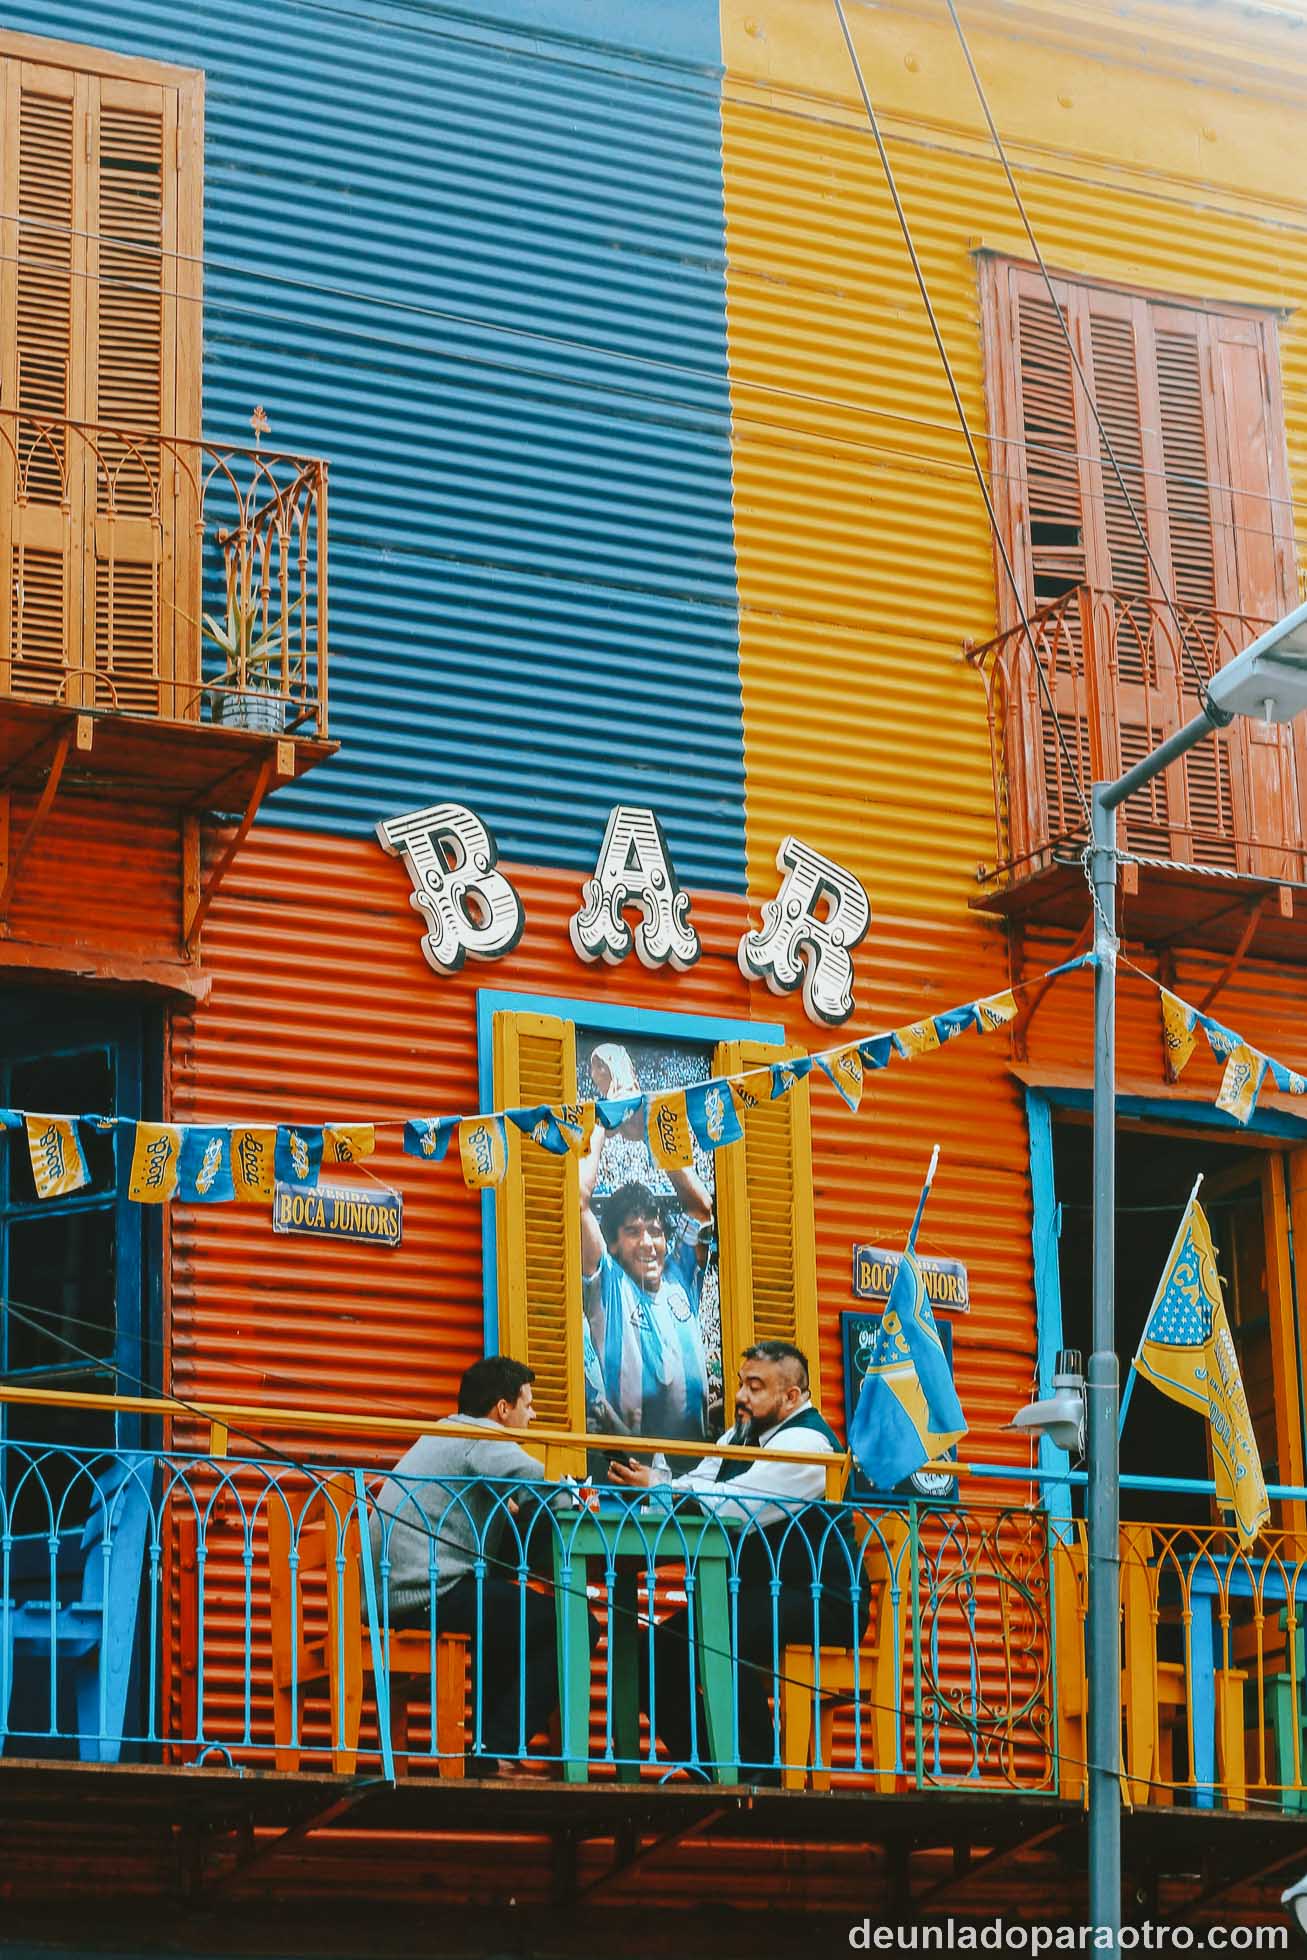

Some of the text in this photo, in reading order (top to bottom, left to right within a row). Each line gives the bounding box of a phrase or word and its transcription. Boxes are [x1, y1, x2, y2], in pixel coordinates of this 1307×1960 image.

[374, 802, 873, 1027] BAR
[660, 1104, 677, 1155] Boca
[238, 1131, 264, 1186] Boca
[280, 1193, 399, 1237] BOCA JUNIORS
[308, 1187, 371, 1204] AVENIDA
[921, 1270, 966, 1304] NIORS
